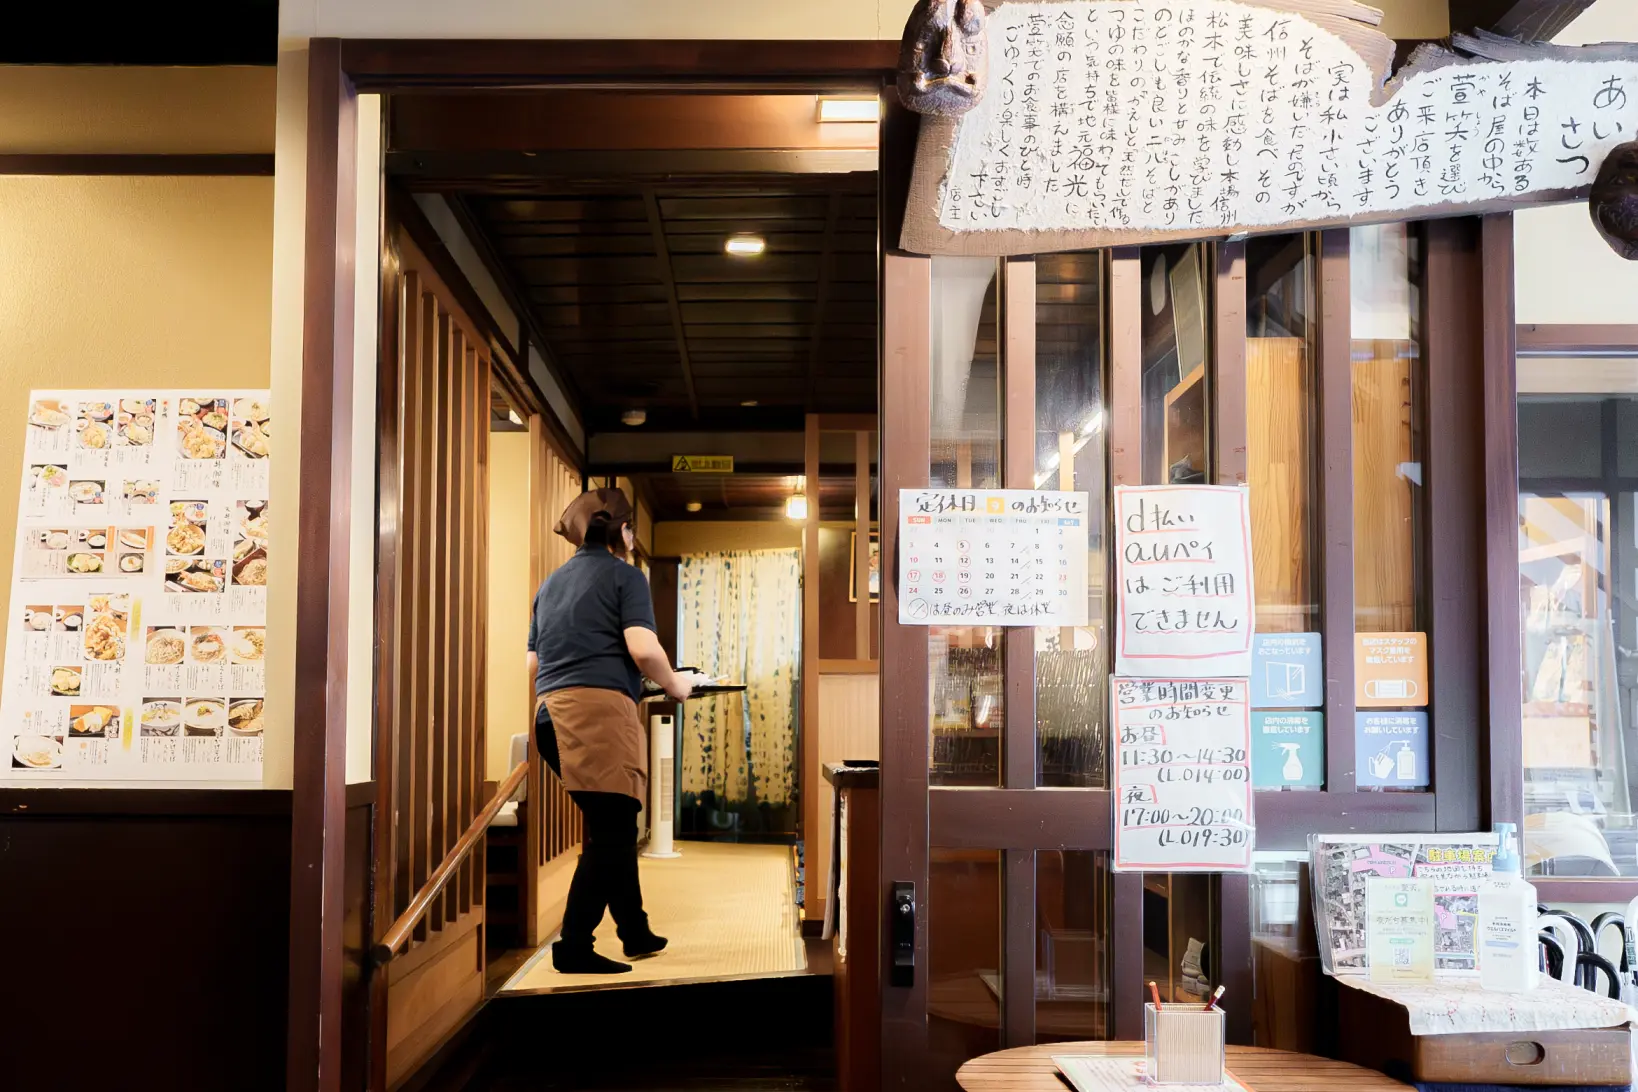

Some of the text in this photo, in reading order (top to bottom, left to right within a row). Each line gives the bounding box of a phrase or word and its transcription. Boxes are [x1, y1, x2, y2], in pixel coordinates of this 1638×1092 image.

[1062, 8, 1099, 214] という気持ちで地元福光に
[1188, 11, 1228, 225] 松本で伝統の味を学びました
[1281, 37, 1320, 215] そばが嫌いだったのですが
[1311, 61, 1354, 212] 実は私小さい頃から
[1382, 99, 1410, 199] ありがとう
[1410, 77, 1442, 196] ご来店頂き
[1477, 71, 1517, 195] そば屋の中から
[1511, 76, 1547, 192] 本日は数ある
[949, 185, 962, 220] 店主
[916, 493, 976, 513] 定休日
[1011, 495, 1082, 514] のお知らせ
[1127, 499, 1194, 532] d払い
[1125, 541, 1213, 563] auペイ
[1127, 573, 1234, 595] はご利用
[1131, 609, 1237, 630] できません
[1118, 682, 1237, 704] 営業時間変更
[1150, 705, 1232, 720] のお知らせ
[1121, 726, 1160, 744] お昼
[1123, 786, 1153, 804] 夜
